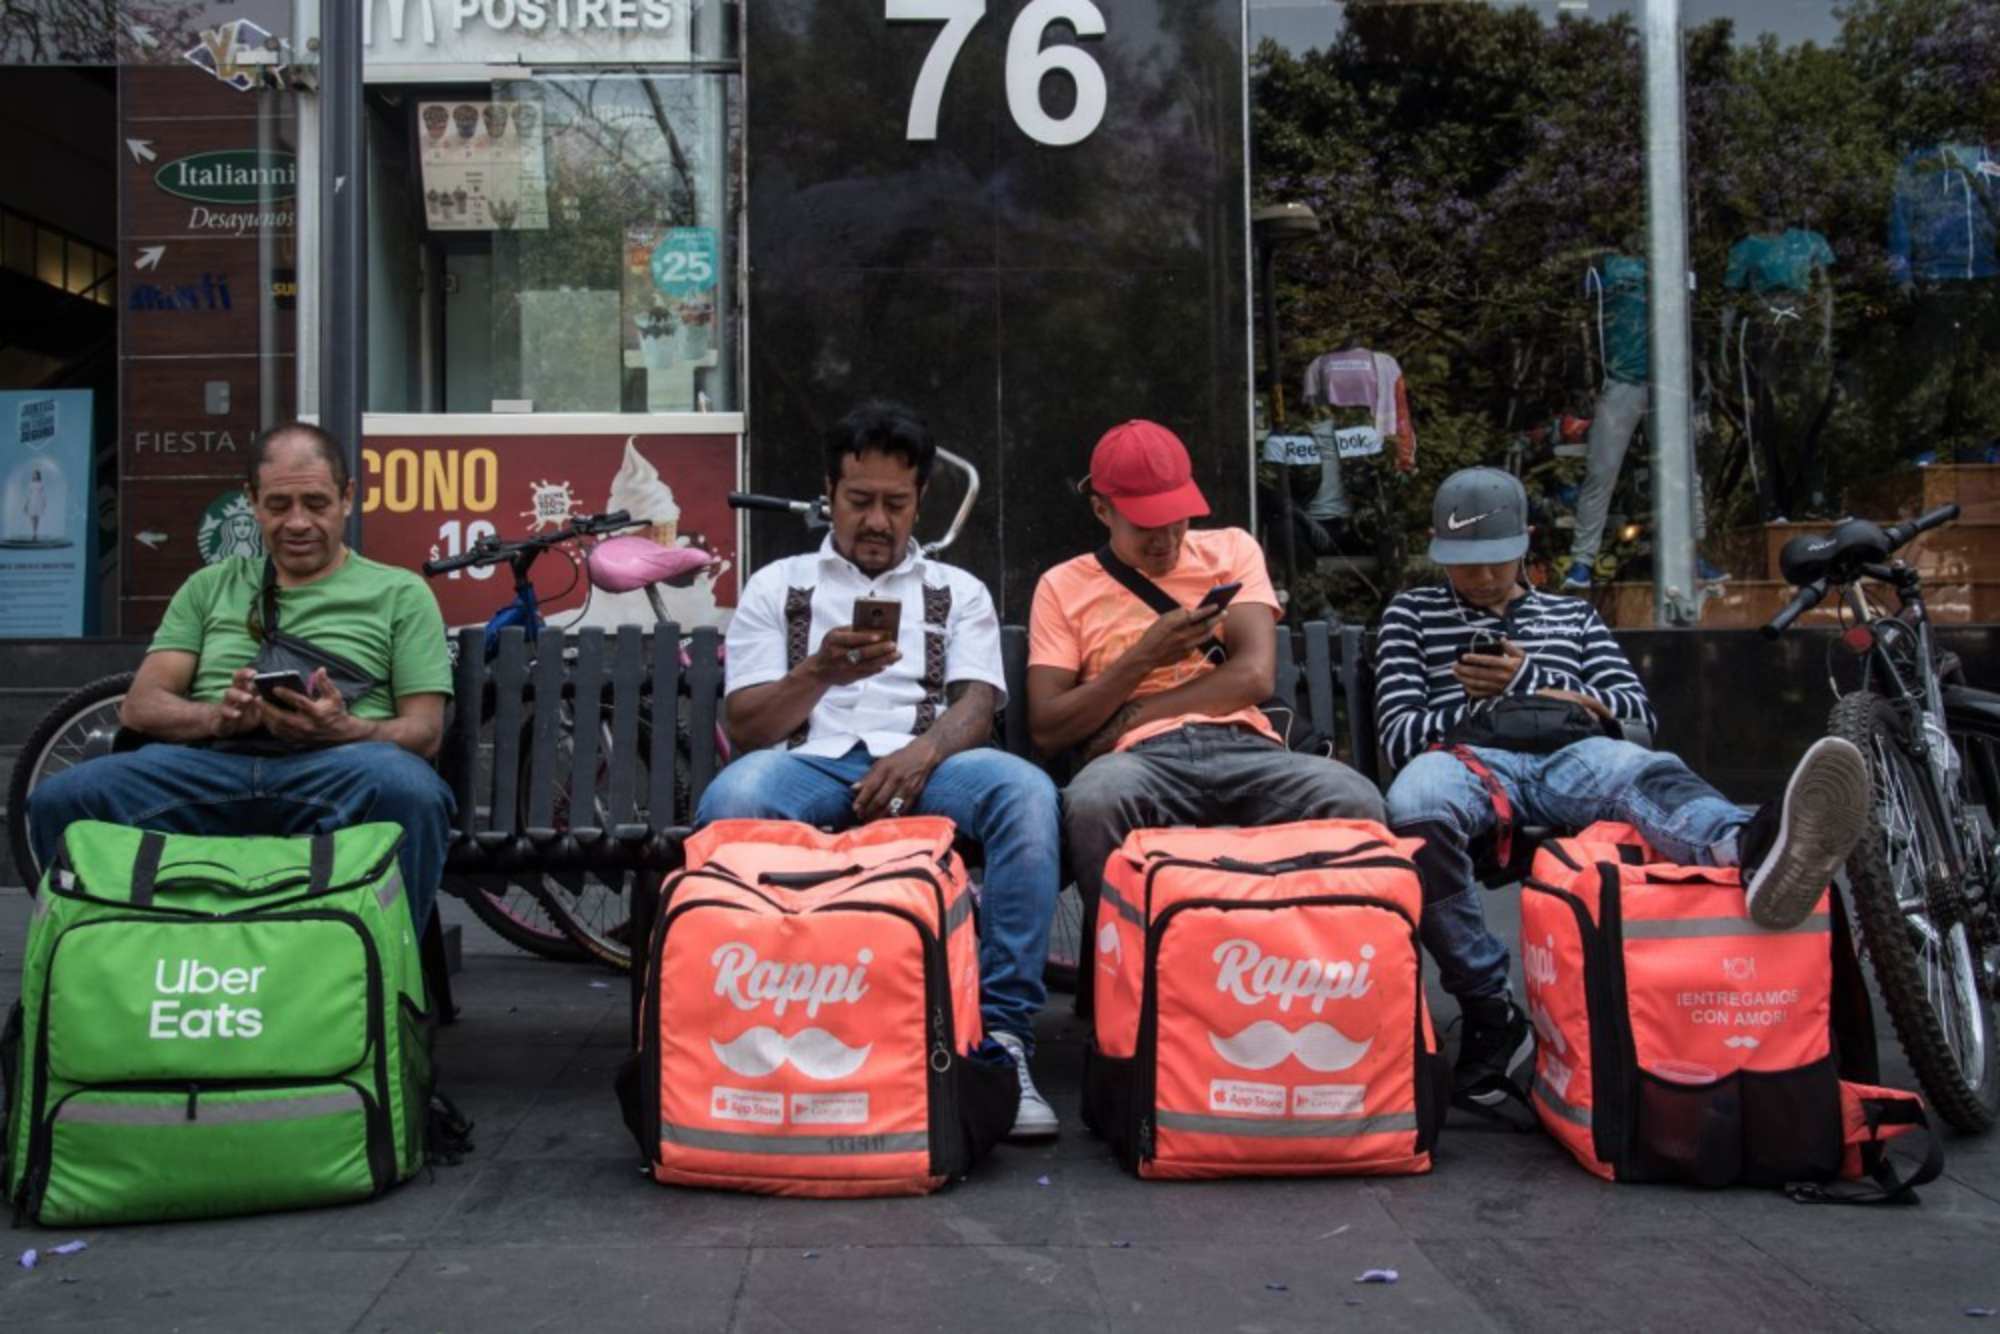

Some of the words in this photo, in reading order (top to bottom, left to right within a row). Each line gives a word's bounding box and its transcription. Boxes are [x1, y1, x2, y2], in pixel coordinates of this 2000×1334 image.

[452, 0, 671, 29] POSTRES
[885, 0, 1107, 146] 76
[136, 431, 236, 453] FIESTA
[156, 959, 266, 994] Uber
[711, 941, 873, 1018] Rappi
[1212, 938, 1375, 1015] Rappi
[150, 1000, 263, 1038] Eats
[1691, 1010, 1729, 1025] CON
[730, 1101, 750, 1115] App
[753, 1103, 781, 1117] Store
[1230, 1094, 1251, 1108] App
[1254, 1096, 1283, 1110] Store
